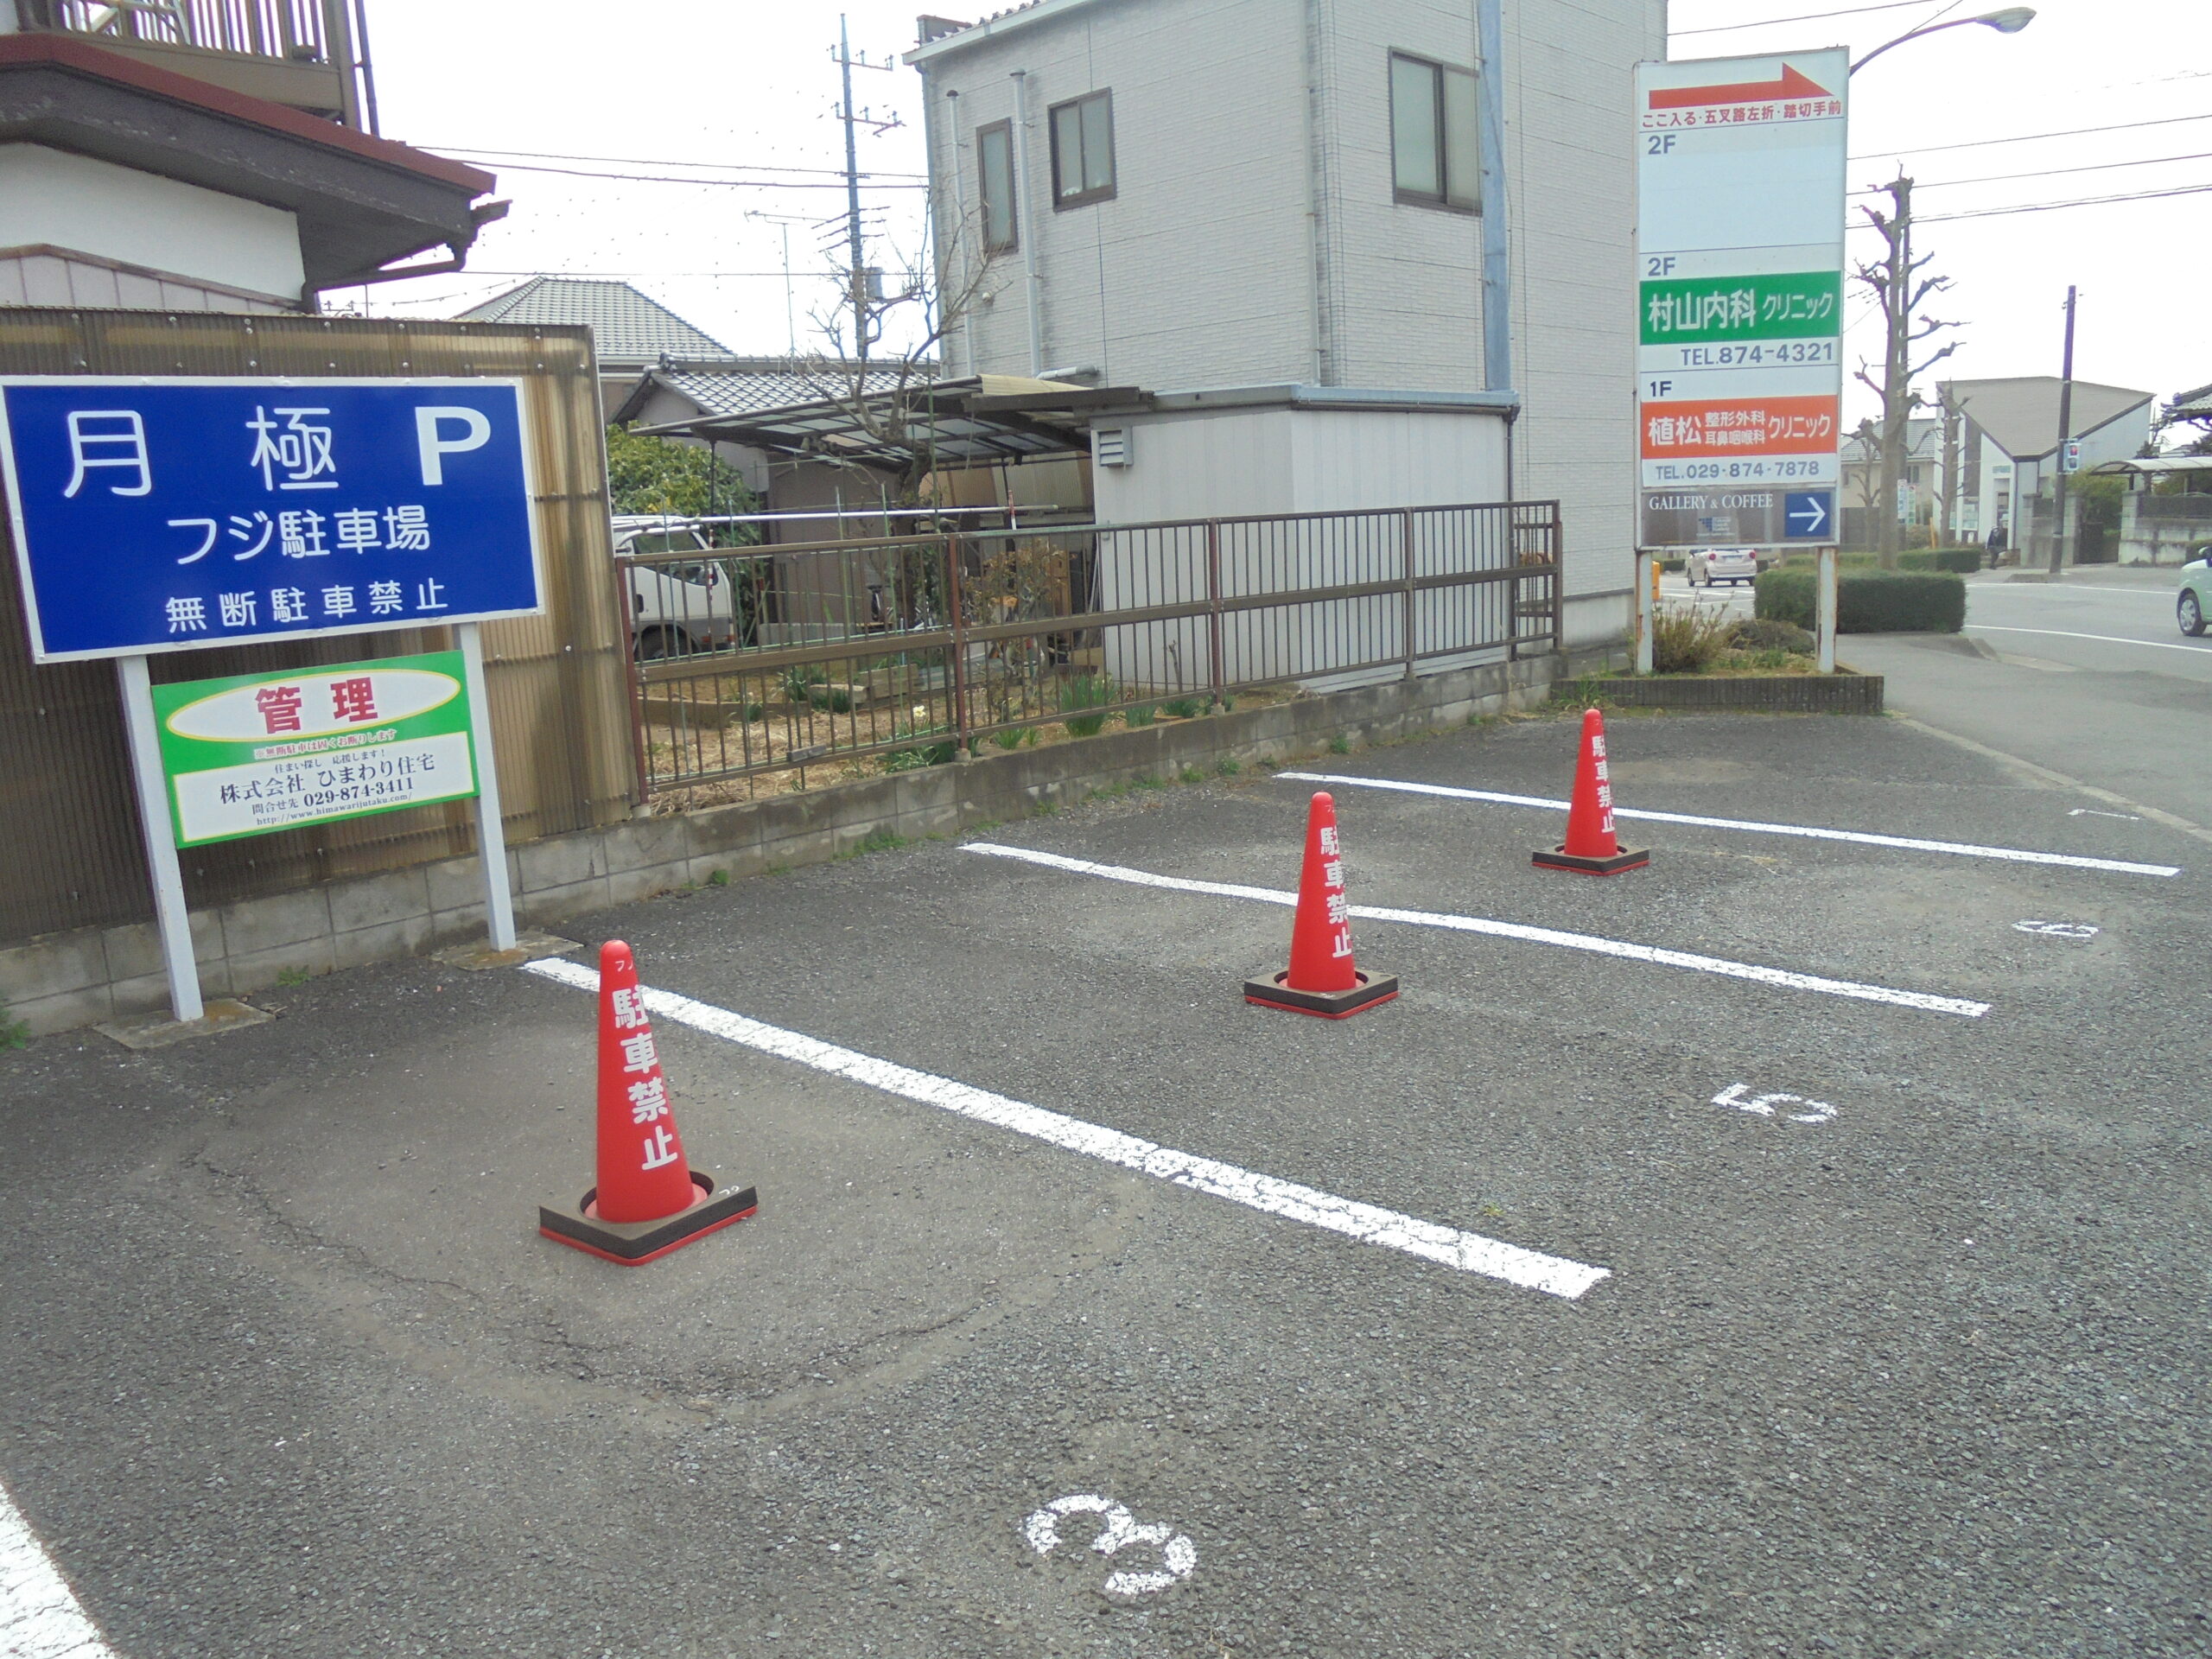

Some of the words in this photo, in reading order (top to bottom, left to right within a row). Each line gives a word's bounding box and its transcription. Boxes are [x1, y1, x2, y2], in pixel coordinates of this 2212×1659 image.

[1648, 135, 1676, 155] 2F
[1648, 257, 1675, 276] 2F
[1648, 289, 1757, 333] 村山内科
[1762, 292, 1834, 321] クリニック
[1649, 381, 1673, 397] 1F
[1648, 416, 1702, 446] 植松
[1704, 410, 1766, 428] 整形外科
[1768, 414, 1831, 440] クリニック
[64, 405, 339, 498] 月極
[415, 405, 492, 486] P
[1649, 495, 1709, 511] GALLERY
[1710, 499, 1718, 509] &
[1721, 493, 1773, 508] COFFEE
[168, 505, 431, 564] フジ駐車場
[165, 577, 448, 633] 無断駐車禁止
[255, 677, 378, 734] 管理
[220, 772, 306, 804] 株式会社
[317, 753, 435, 787] ひまわり住宅
[275, 759, 323, 774] 住まい探し
[251, 797, 300, 815] 問合せ先
[303, 777, 414, 807] 029-874-3411
[256, 792, 413, 826] http://www.himawarijutaku.com/
[612, 984, 678, 1171] 駐車禁止
[1710, 1082, 1839, 1123] 5
[1018, 1493, 1198, 1596] 3
